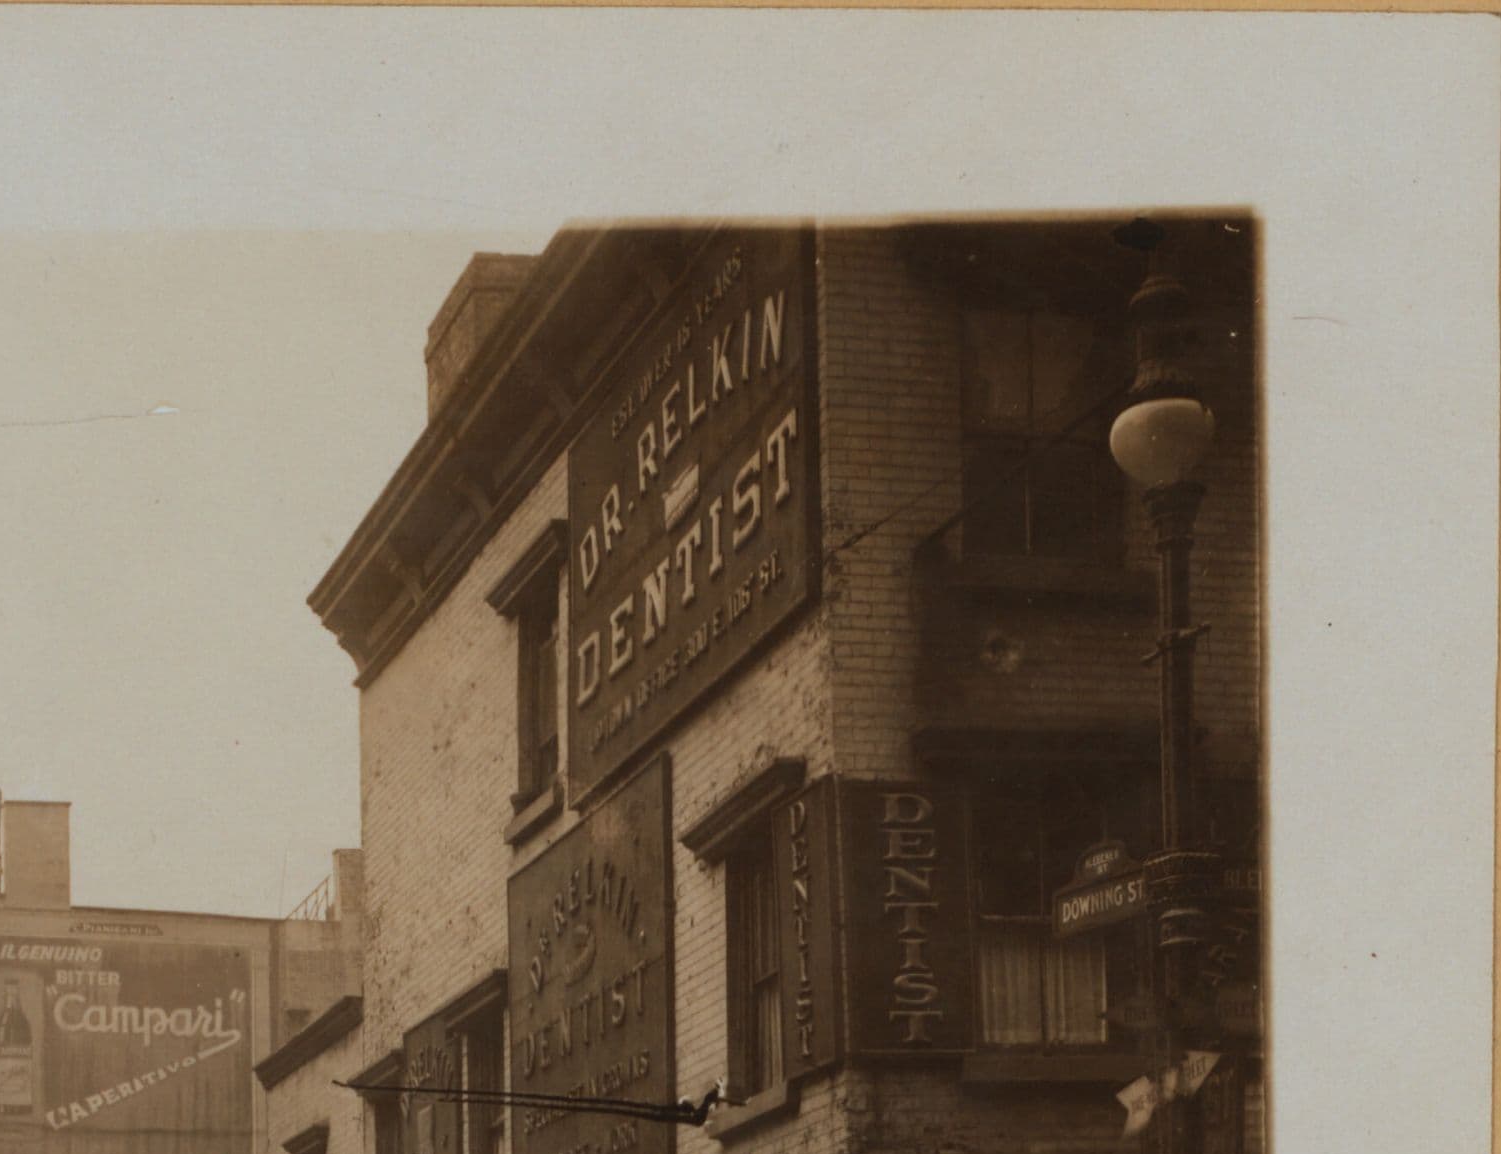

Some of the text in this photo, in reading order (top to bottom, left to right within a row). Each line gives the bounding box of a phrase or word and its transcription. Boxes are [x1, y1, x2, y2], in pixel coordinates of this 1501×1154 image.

[579, 289, 786, 593] DR. RELKIN
[576, 407, 798, 708] DENTIST
[878, 793, 944, 1043] DENTIST
[1063, 884, 1123, 923] DOWNING
[17, 944, 103, 962] GENUINO
[56, 970, 120, 986] BITTER
[523, 962, 646, 1081] DENTIST
[45, 1056, 197, 1130] L'APERITIVO
